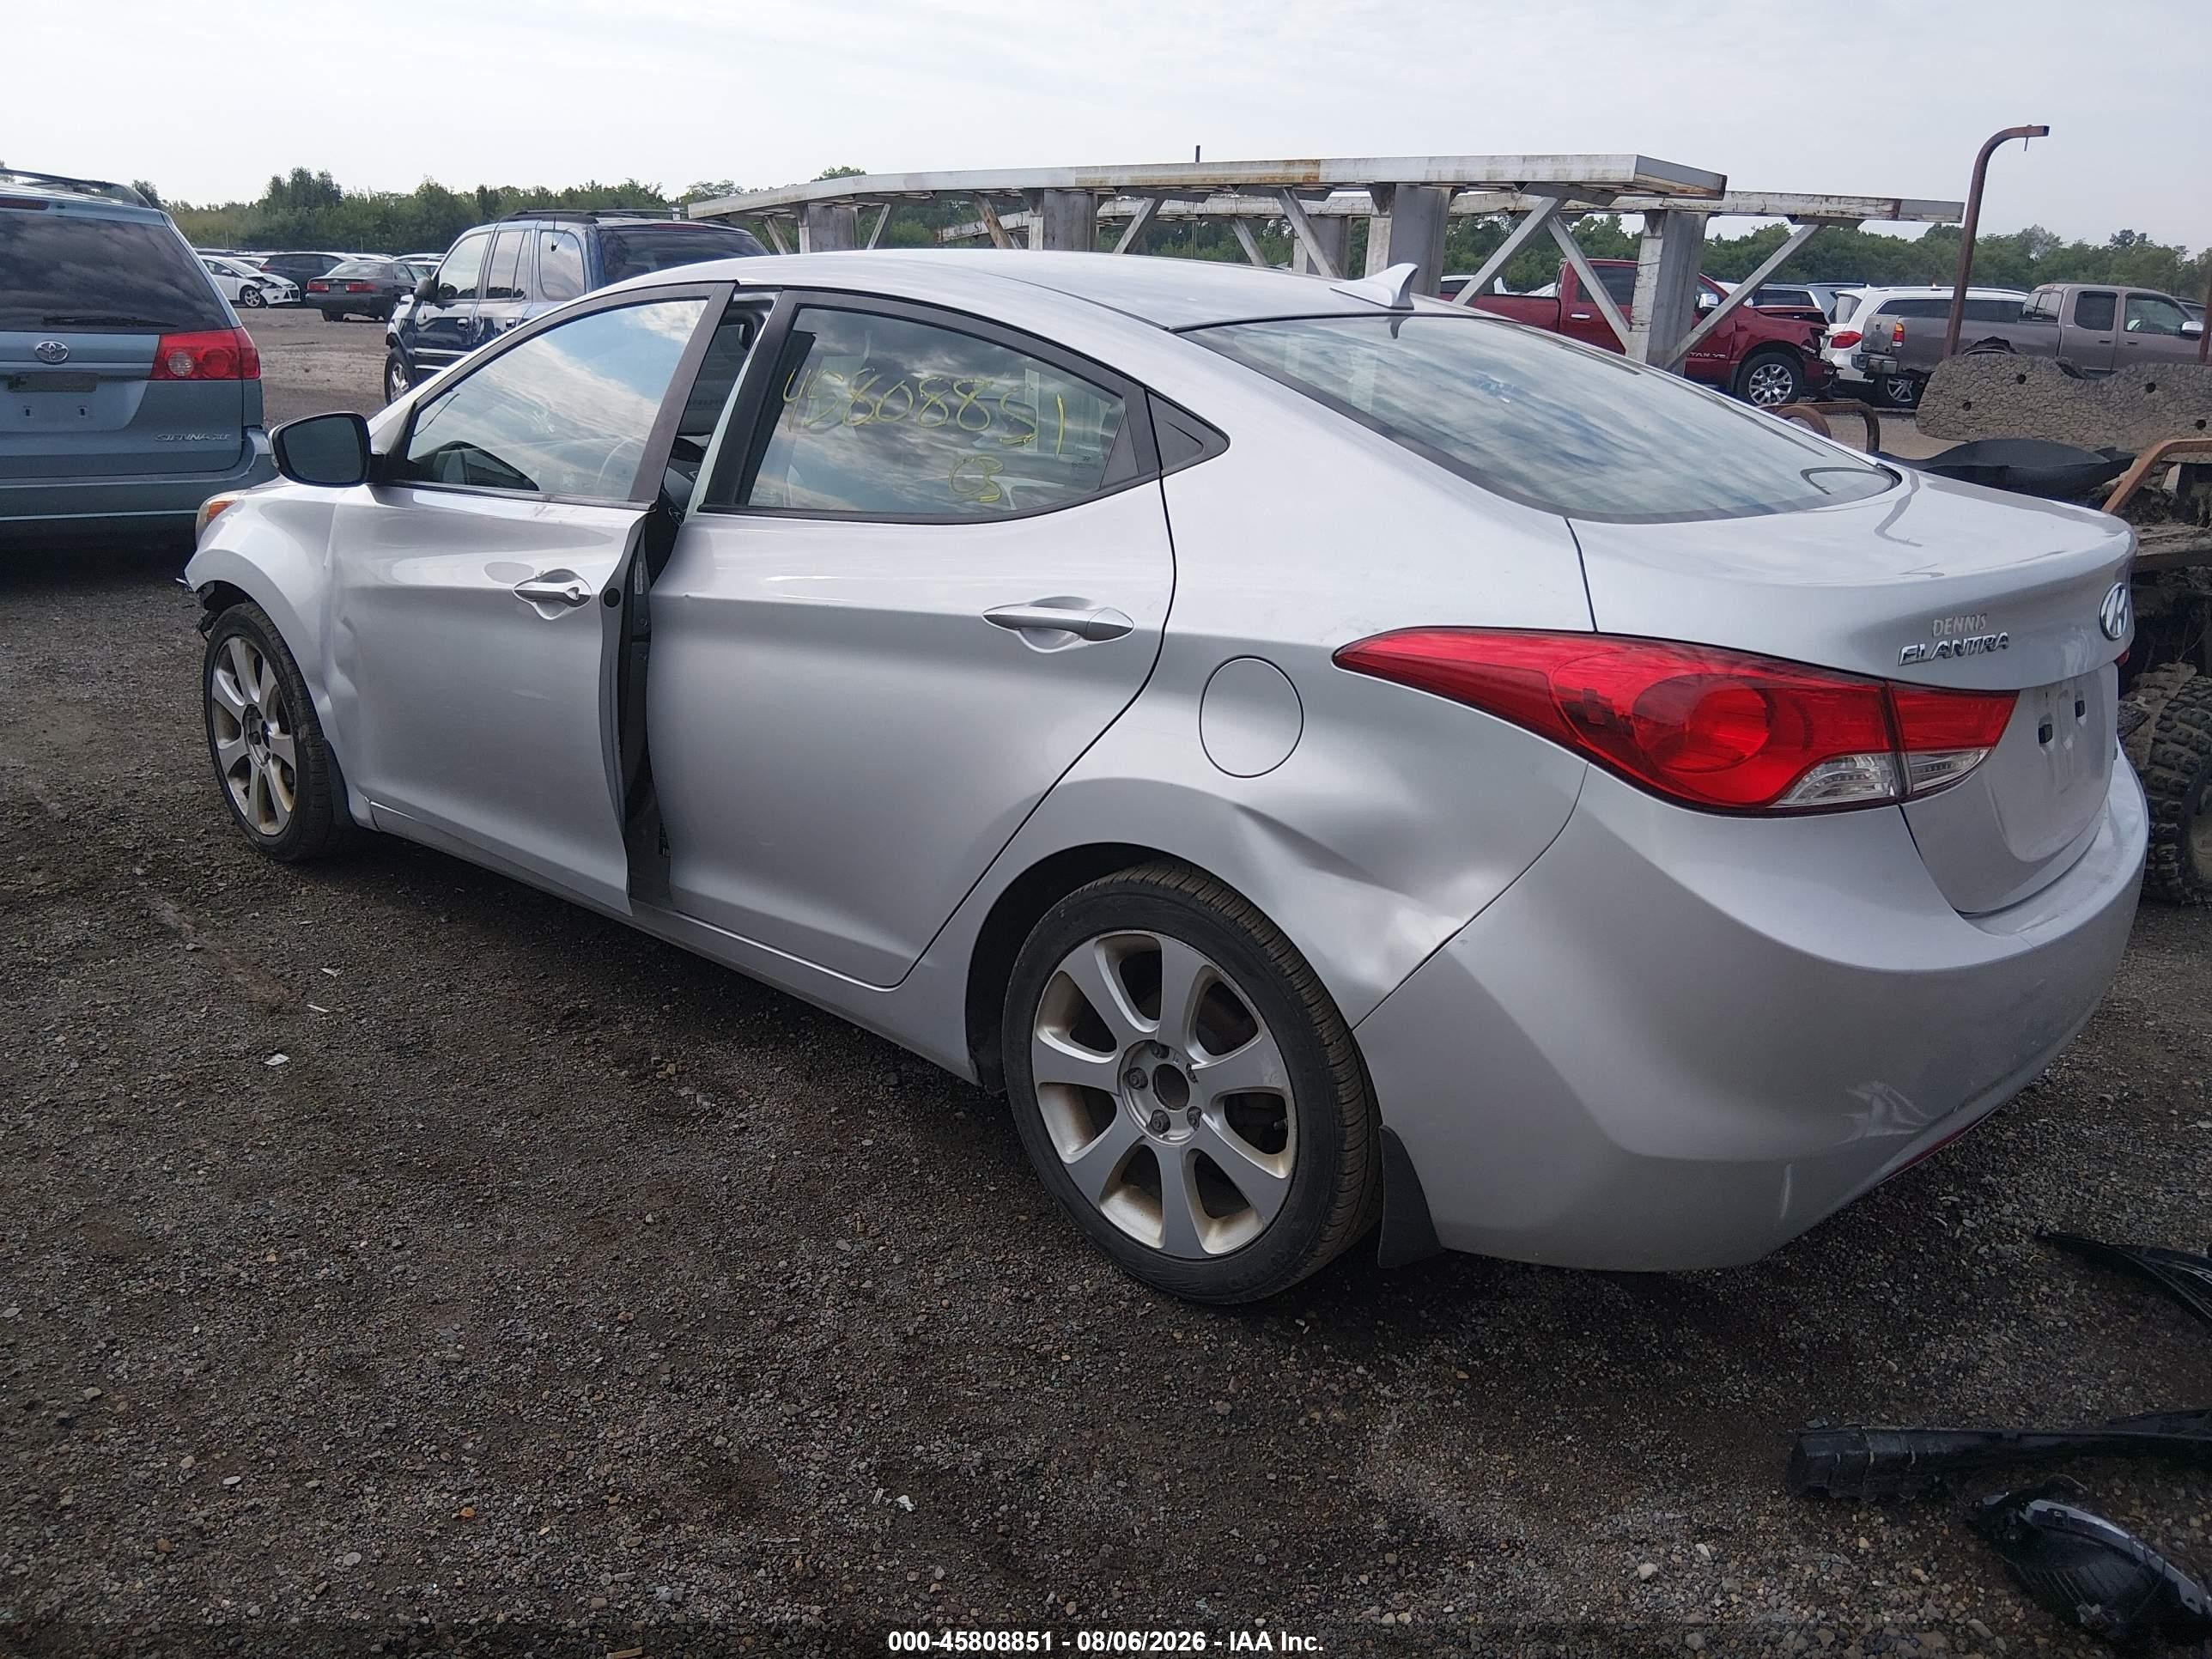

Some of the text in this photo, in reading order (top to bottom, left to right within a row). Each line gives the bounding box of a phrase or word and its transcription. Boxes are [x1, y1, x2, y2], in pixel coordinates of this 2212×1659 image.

[782, 367, 1066, 459] 45808851
[155, 433, 210, 441] SIENNA
[1933, 613, 1987, 637] DENNIS
[1898, 631, 2009, 666] ELANTRA
